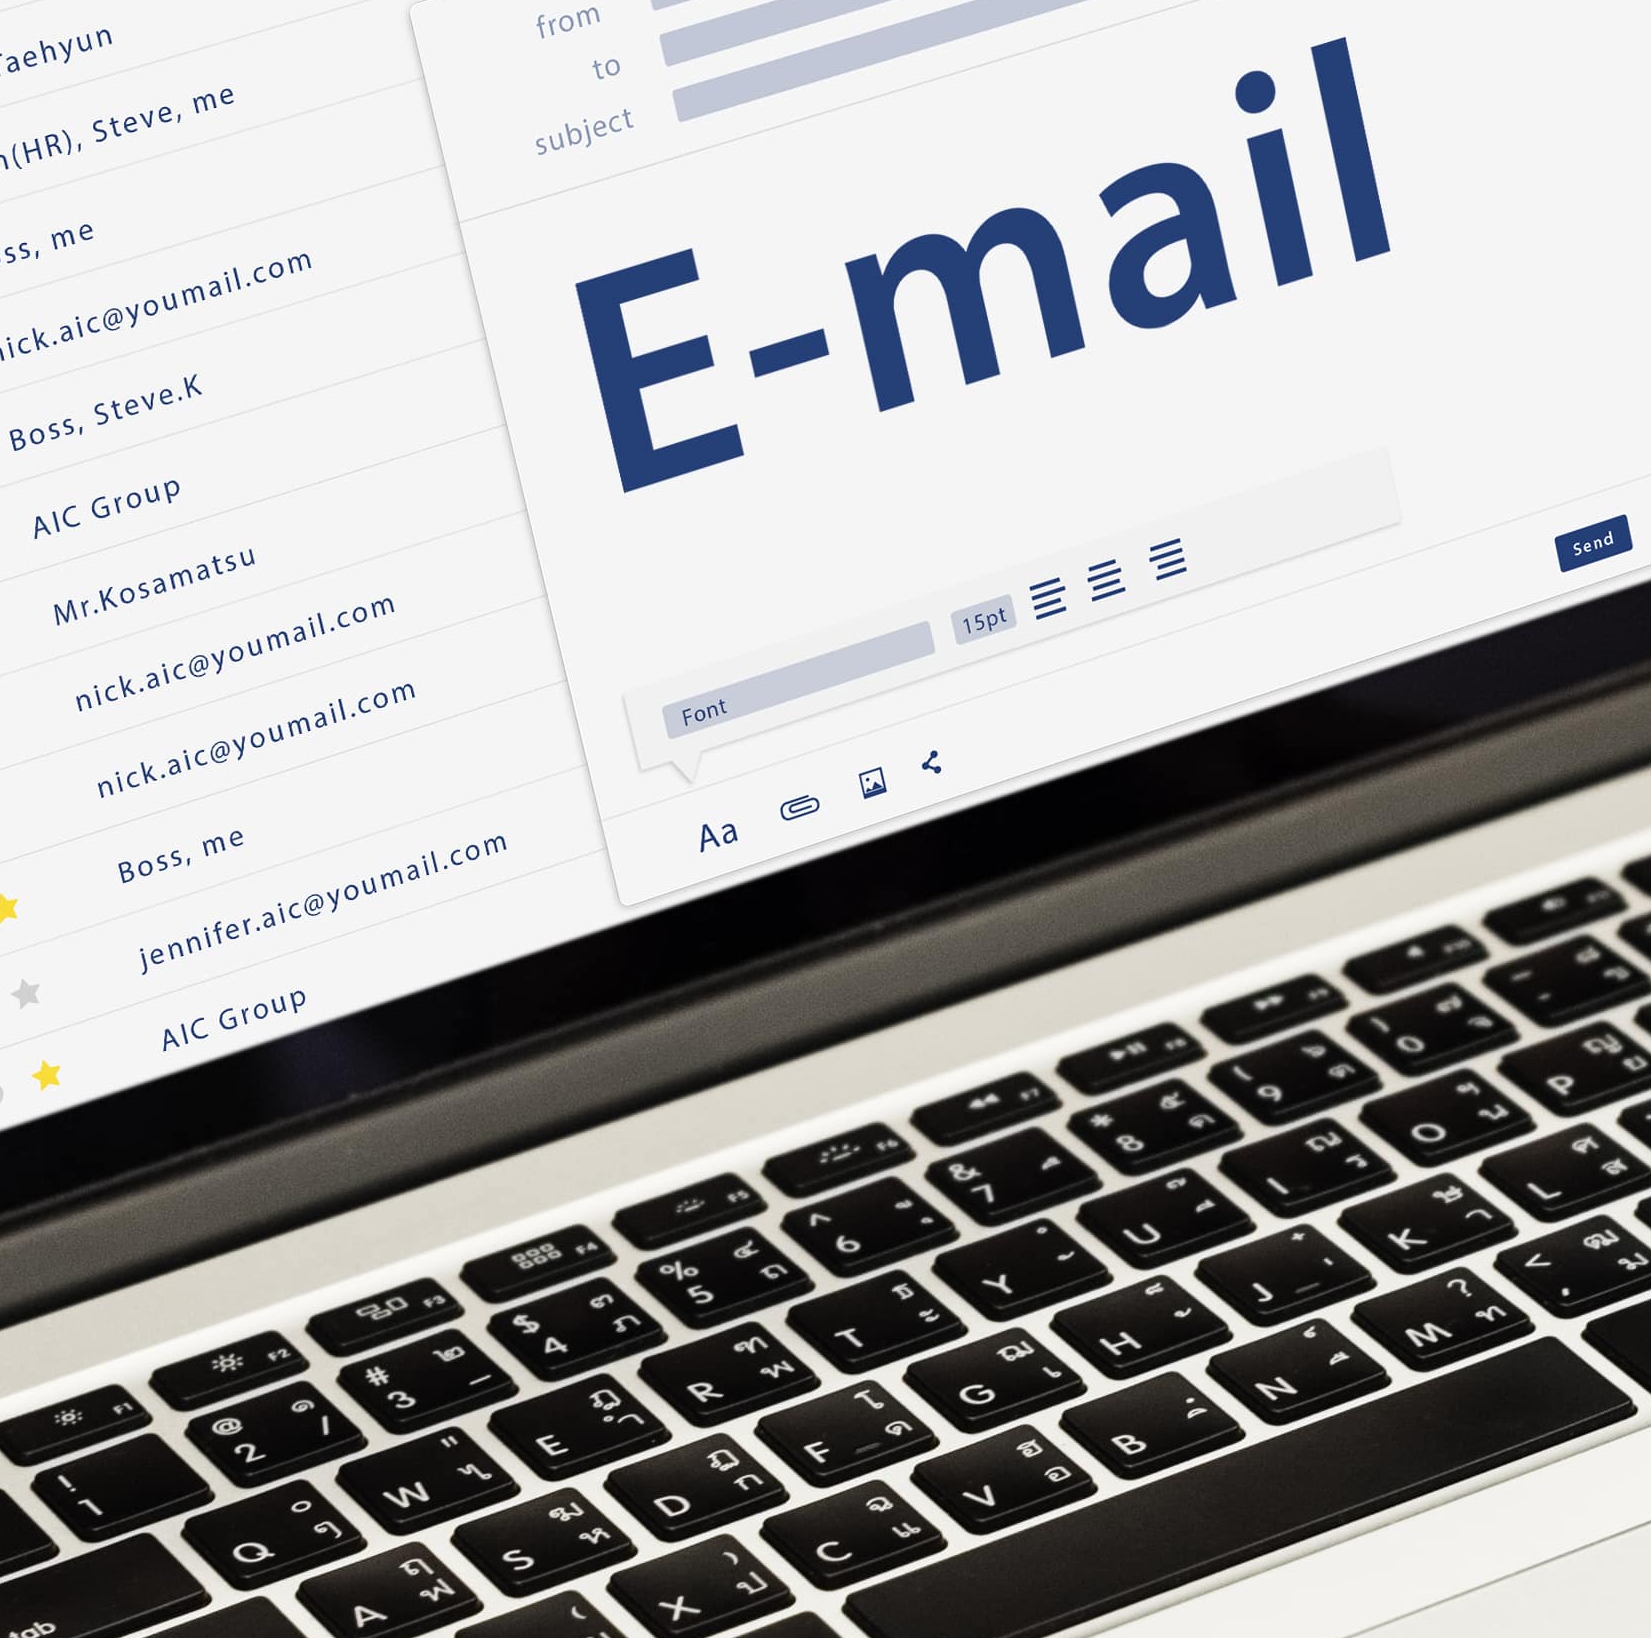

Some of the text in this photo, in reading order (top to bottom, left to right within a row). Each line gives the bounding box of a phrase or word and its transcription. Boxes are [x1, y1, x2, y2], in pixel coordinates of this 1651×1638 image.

[536, 6, 601, 40] from
[591, 58, 621, 80] to
[92, 105, 182, 143] Steve,
[192, 87, 235, 115] me
[535, 108, 635, 156] subject
[50, 223, 94, 251] me
[574, 35, 1392, 494] E-mail
[8, 373, 203, 452] Boss, Steve.K
[33, 479, 181, 540] AIC Group
[1571, 527, 1616, 558] Send
[53, 548, 256, 627] Mr.Kosamatsu
[961, 604, 1009, 636] 15pt
[75, 597, 395, 713] nick.aic@youmail.com
[681, 698, 730, 728] Font
[97, 683, 416, 799] nick.aic@youmail.com
[699, 823, 739, 854] Aa
[117, 830, 244, 884] Boss, me
[139, 835, 508, 976] jennifer.aic@youmail.com
[162, 989, 306, 1053] AIC Group
[1396, 1035, 1425, 1053] 0
[1256, 1084, 1283, 1102] 9
[1546, 1075, 1575, 1096] P
[1115, 1134, 1145, 1152] 8
[1410, 1122, 1447, 1143] O
[948, 1163, 981, 1182] &
[727, 1189, 750, 1203] F5
[970, 1183, 995, 1204] 7
[1526, 1182, 1562, 1200] L
[835, 1235, 861, 1253] 6
[1122, 1222, 1162, 1245] U
[1387, 1227, 1428, 1251] K
[575, 1241, 599, 1255] F4
[659, 1260, 699, 1281] %
[686, 1284, 714, 1304] 5
[981, 1273, 1013, 1295] Y
[1251, 1282, 1274, 1303] J
[422, 1294, 447, 1308] F3
[512, 1314, 541, 1334] $
[1404, 1322, 1453, 1348] M
[544, 1336, 569, 1354] 4
[833, 1327, 864, 1348] T
[1099, 1331, 1143, 1356] H
[267, 1348, 291, 1362] F2
[365, 1366, 389, 1387] #
[387, 1390, 417, 1409] 3
[686, 1382, 725, 1403] R
[958, 1384, 996, 1405] G
[1254, 1376, 1298, 1401] N
[112, 1402, 134, 1415] F1
[211, 1417, 244, 1436] @
[233, 1442, 267, 1464] 2
[535, 1434, 569, 1457] E
[803, 1441, 830, 1464] F
[1110, 1434, 1147, 1456] B
[382, 1481, 431, 1509] W
[961, 1484, 996, 1507] V
[77, 1498, 104, 1516] 1
[653, 1495, 691, 1518] D
[232, 1541, 276, 1564] Q
[502, 1549, 535, 1571] S
[816, 1540, 853, 1562] C
[353, 1605, 388, 1629] A
[658, 1595, 702, 1622] X
